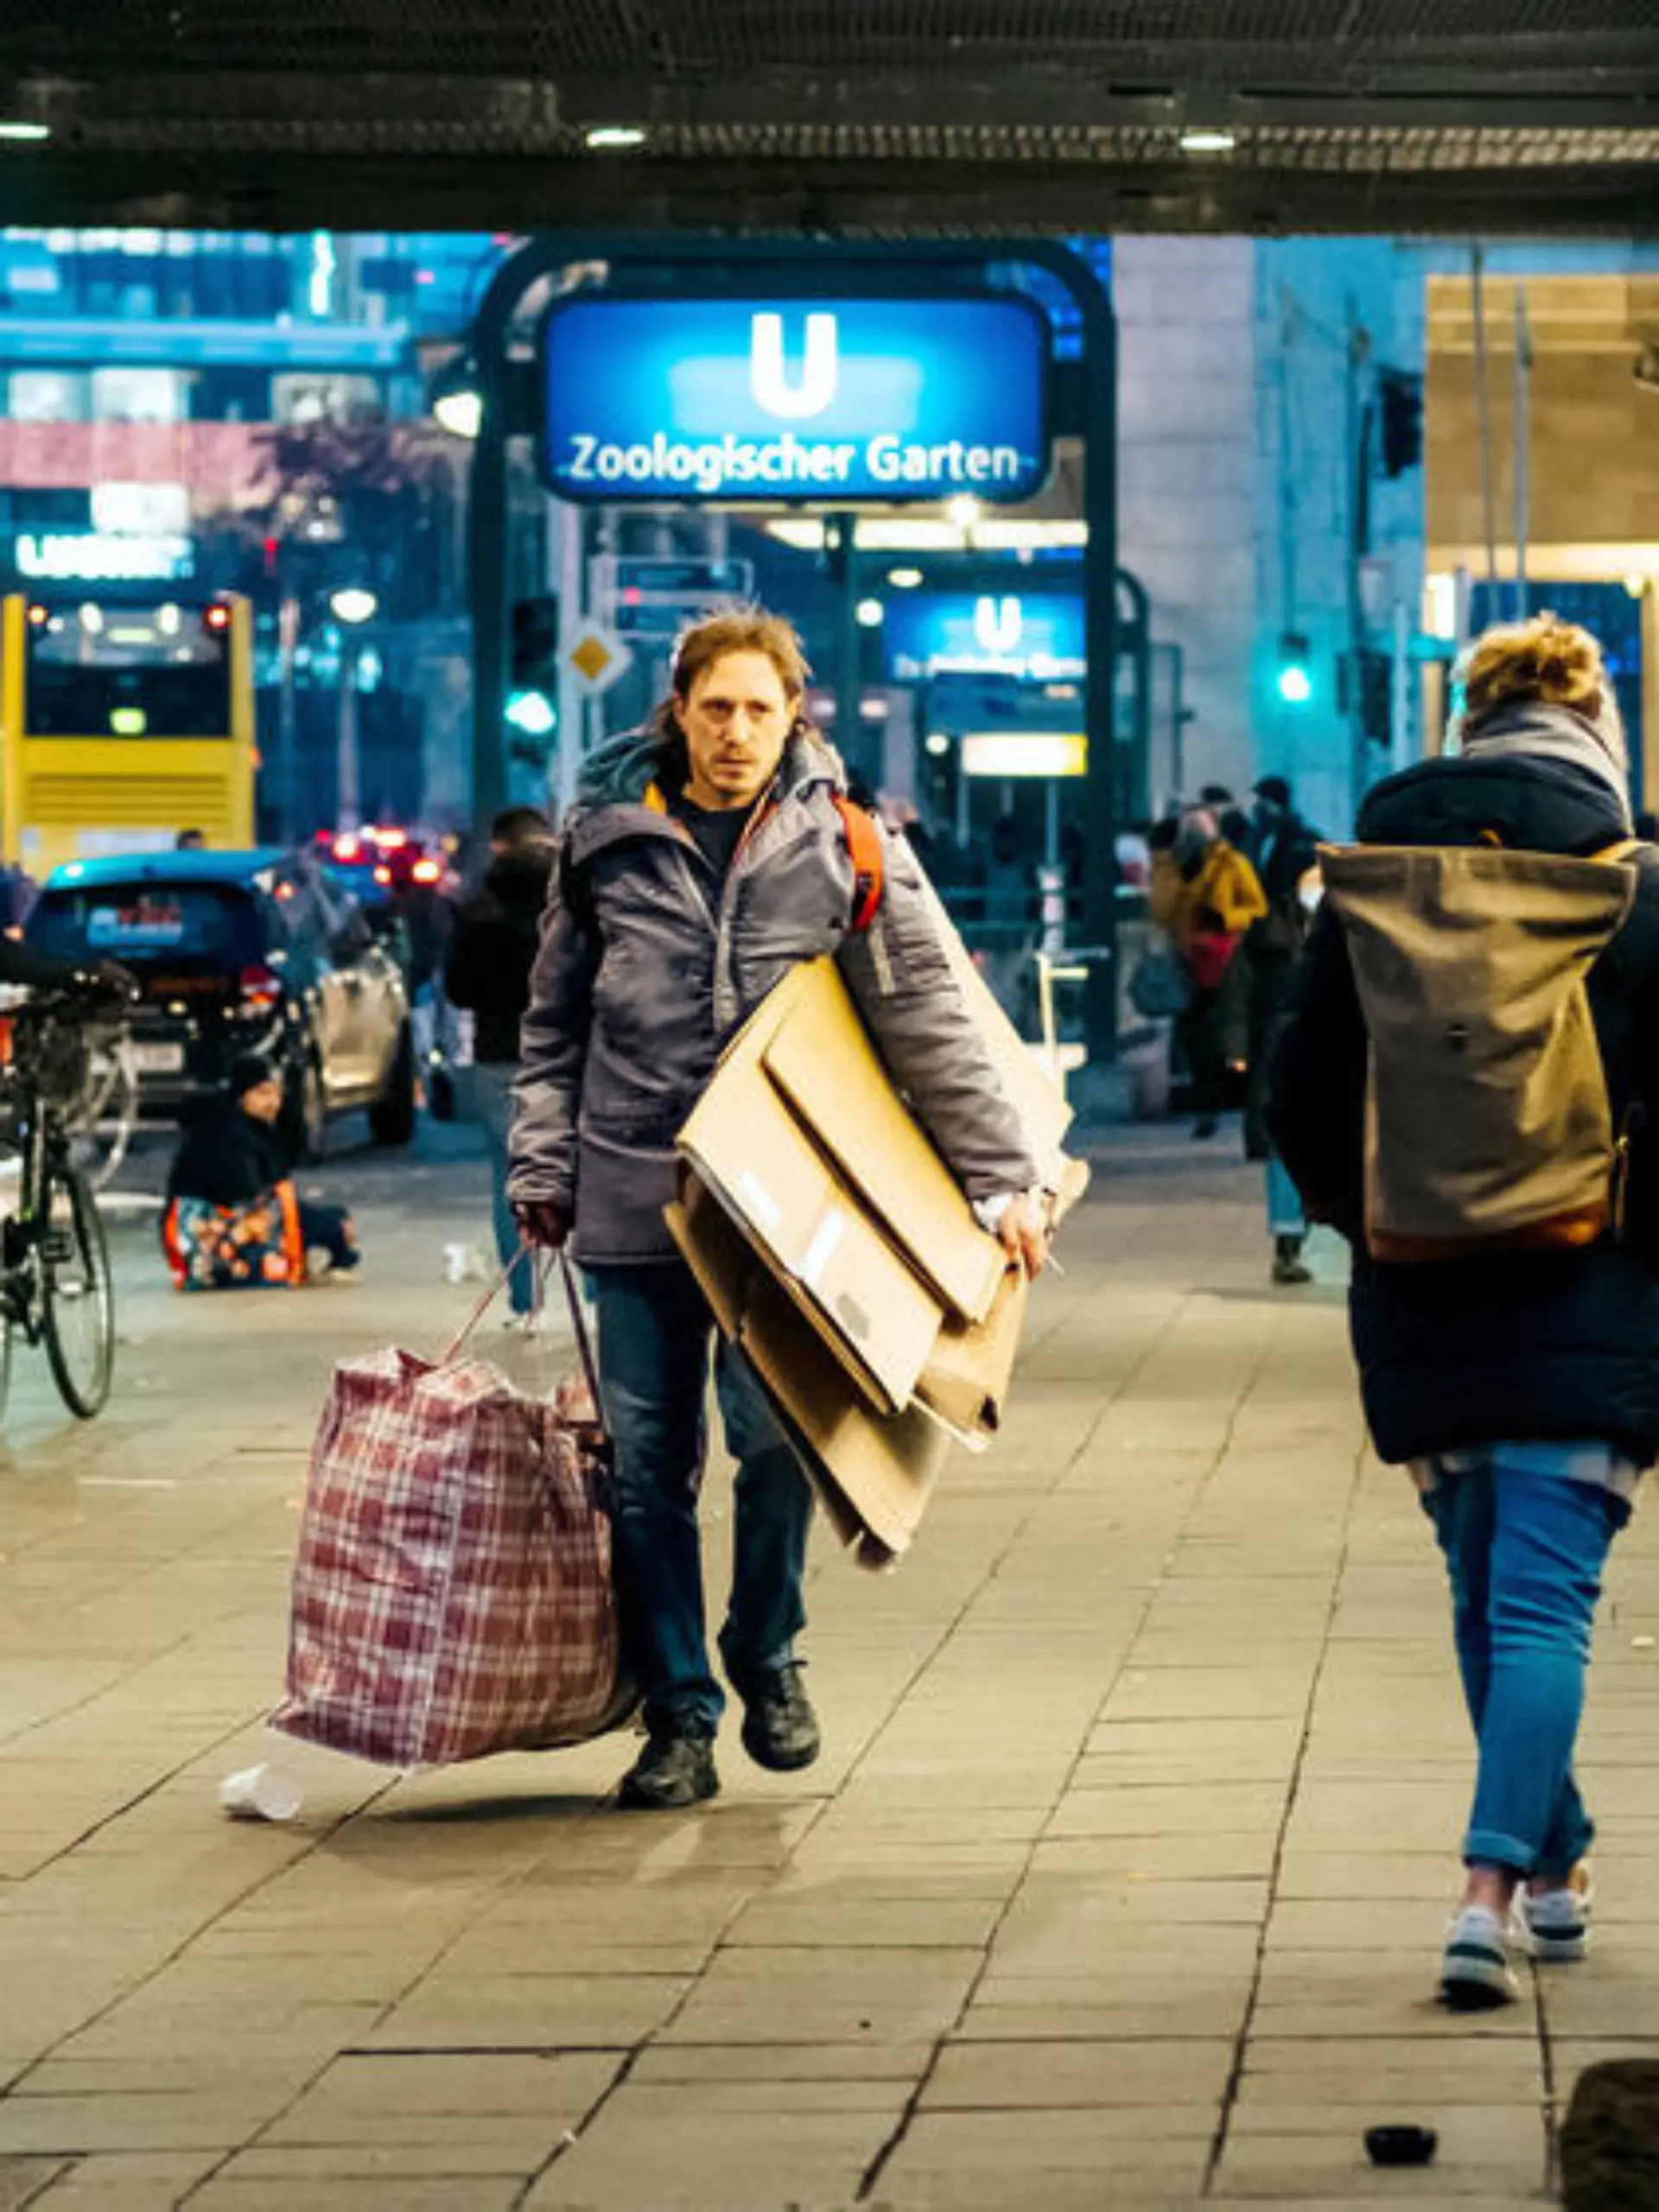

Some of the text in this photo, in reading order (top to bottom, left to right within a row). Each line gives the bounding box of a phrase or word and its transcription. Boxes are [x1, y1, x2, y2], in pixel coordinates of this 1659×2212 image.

[750, 312, 838, 418] U
[569, 433, 1019, 491] Zoologischer Garten
[974, 595, 1021, 650] U
